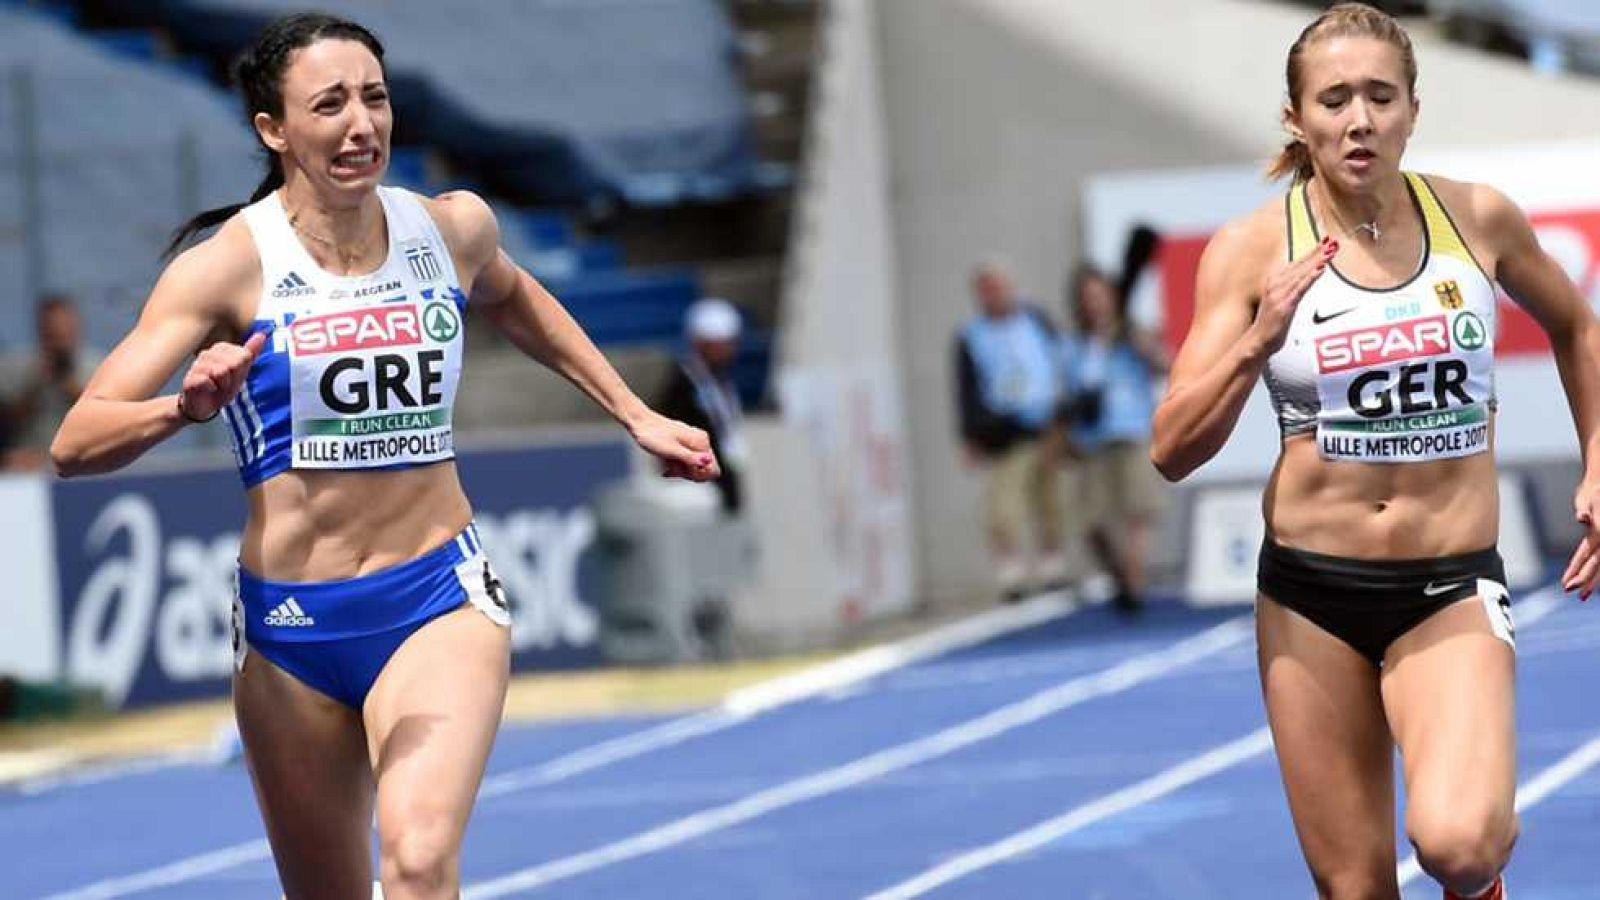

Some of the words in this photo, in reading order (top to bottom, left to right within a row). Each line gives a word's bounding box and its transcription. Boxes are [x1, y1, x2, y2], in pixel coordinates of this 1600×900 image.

[272, 286, 316, 298] adidas
[354, 280, 402, 298] AEGEAN
[296, 310, 419, 350] SPAR
[1319, 321, 1447, 368] SPAR
[319, 350, 444, 414] GRE
[1346, 359, 1475, 419] GER
[351, 417, 382, 433] RUN
[386, 411, 432, 428] CLEAN
[1373, 417, 1405, 432] RUN
[1408, 412, 1458, 429] CLEAN
[299, 440, 339, 462] LILLE
[342, 434, 437, 462] METROPOLE
[1323, 435, 1363, 457] LILLE
[1366, 431, 1462, 457] METROPOLE
[1465, 425, 1487, 449] 2017
[263, 614, 315, 627] adidas
